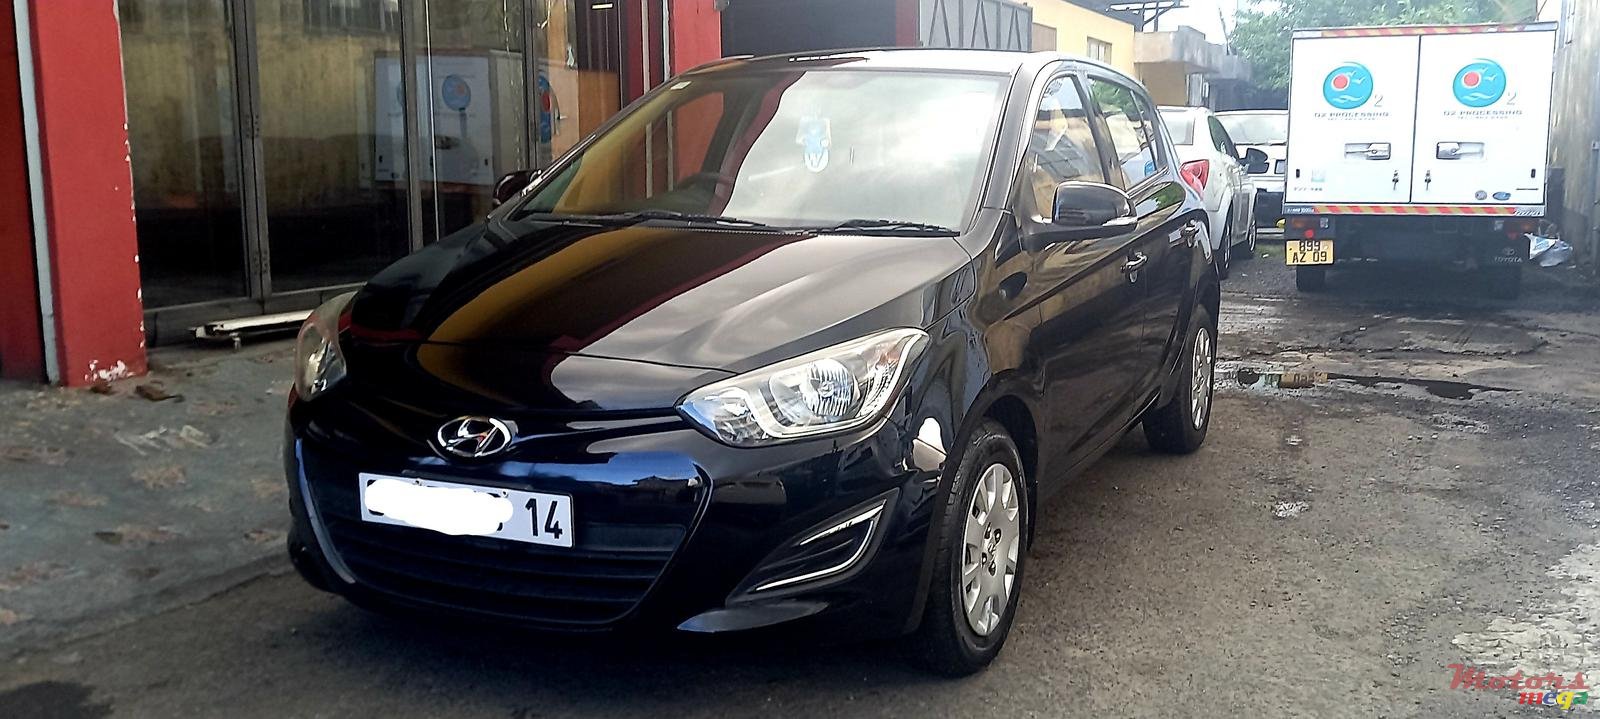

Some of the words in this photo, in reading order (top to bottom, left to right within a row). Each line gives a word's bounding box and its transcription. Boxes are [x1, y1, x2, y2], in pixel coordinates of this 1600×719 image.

[1299, 240, 1321, 252] 899
[1292, 252, 1307, 263] AZ
[1313, 251, 1327, 262] 09
[525, 497, 563, 540] 14
